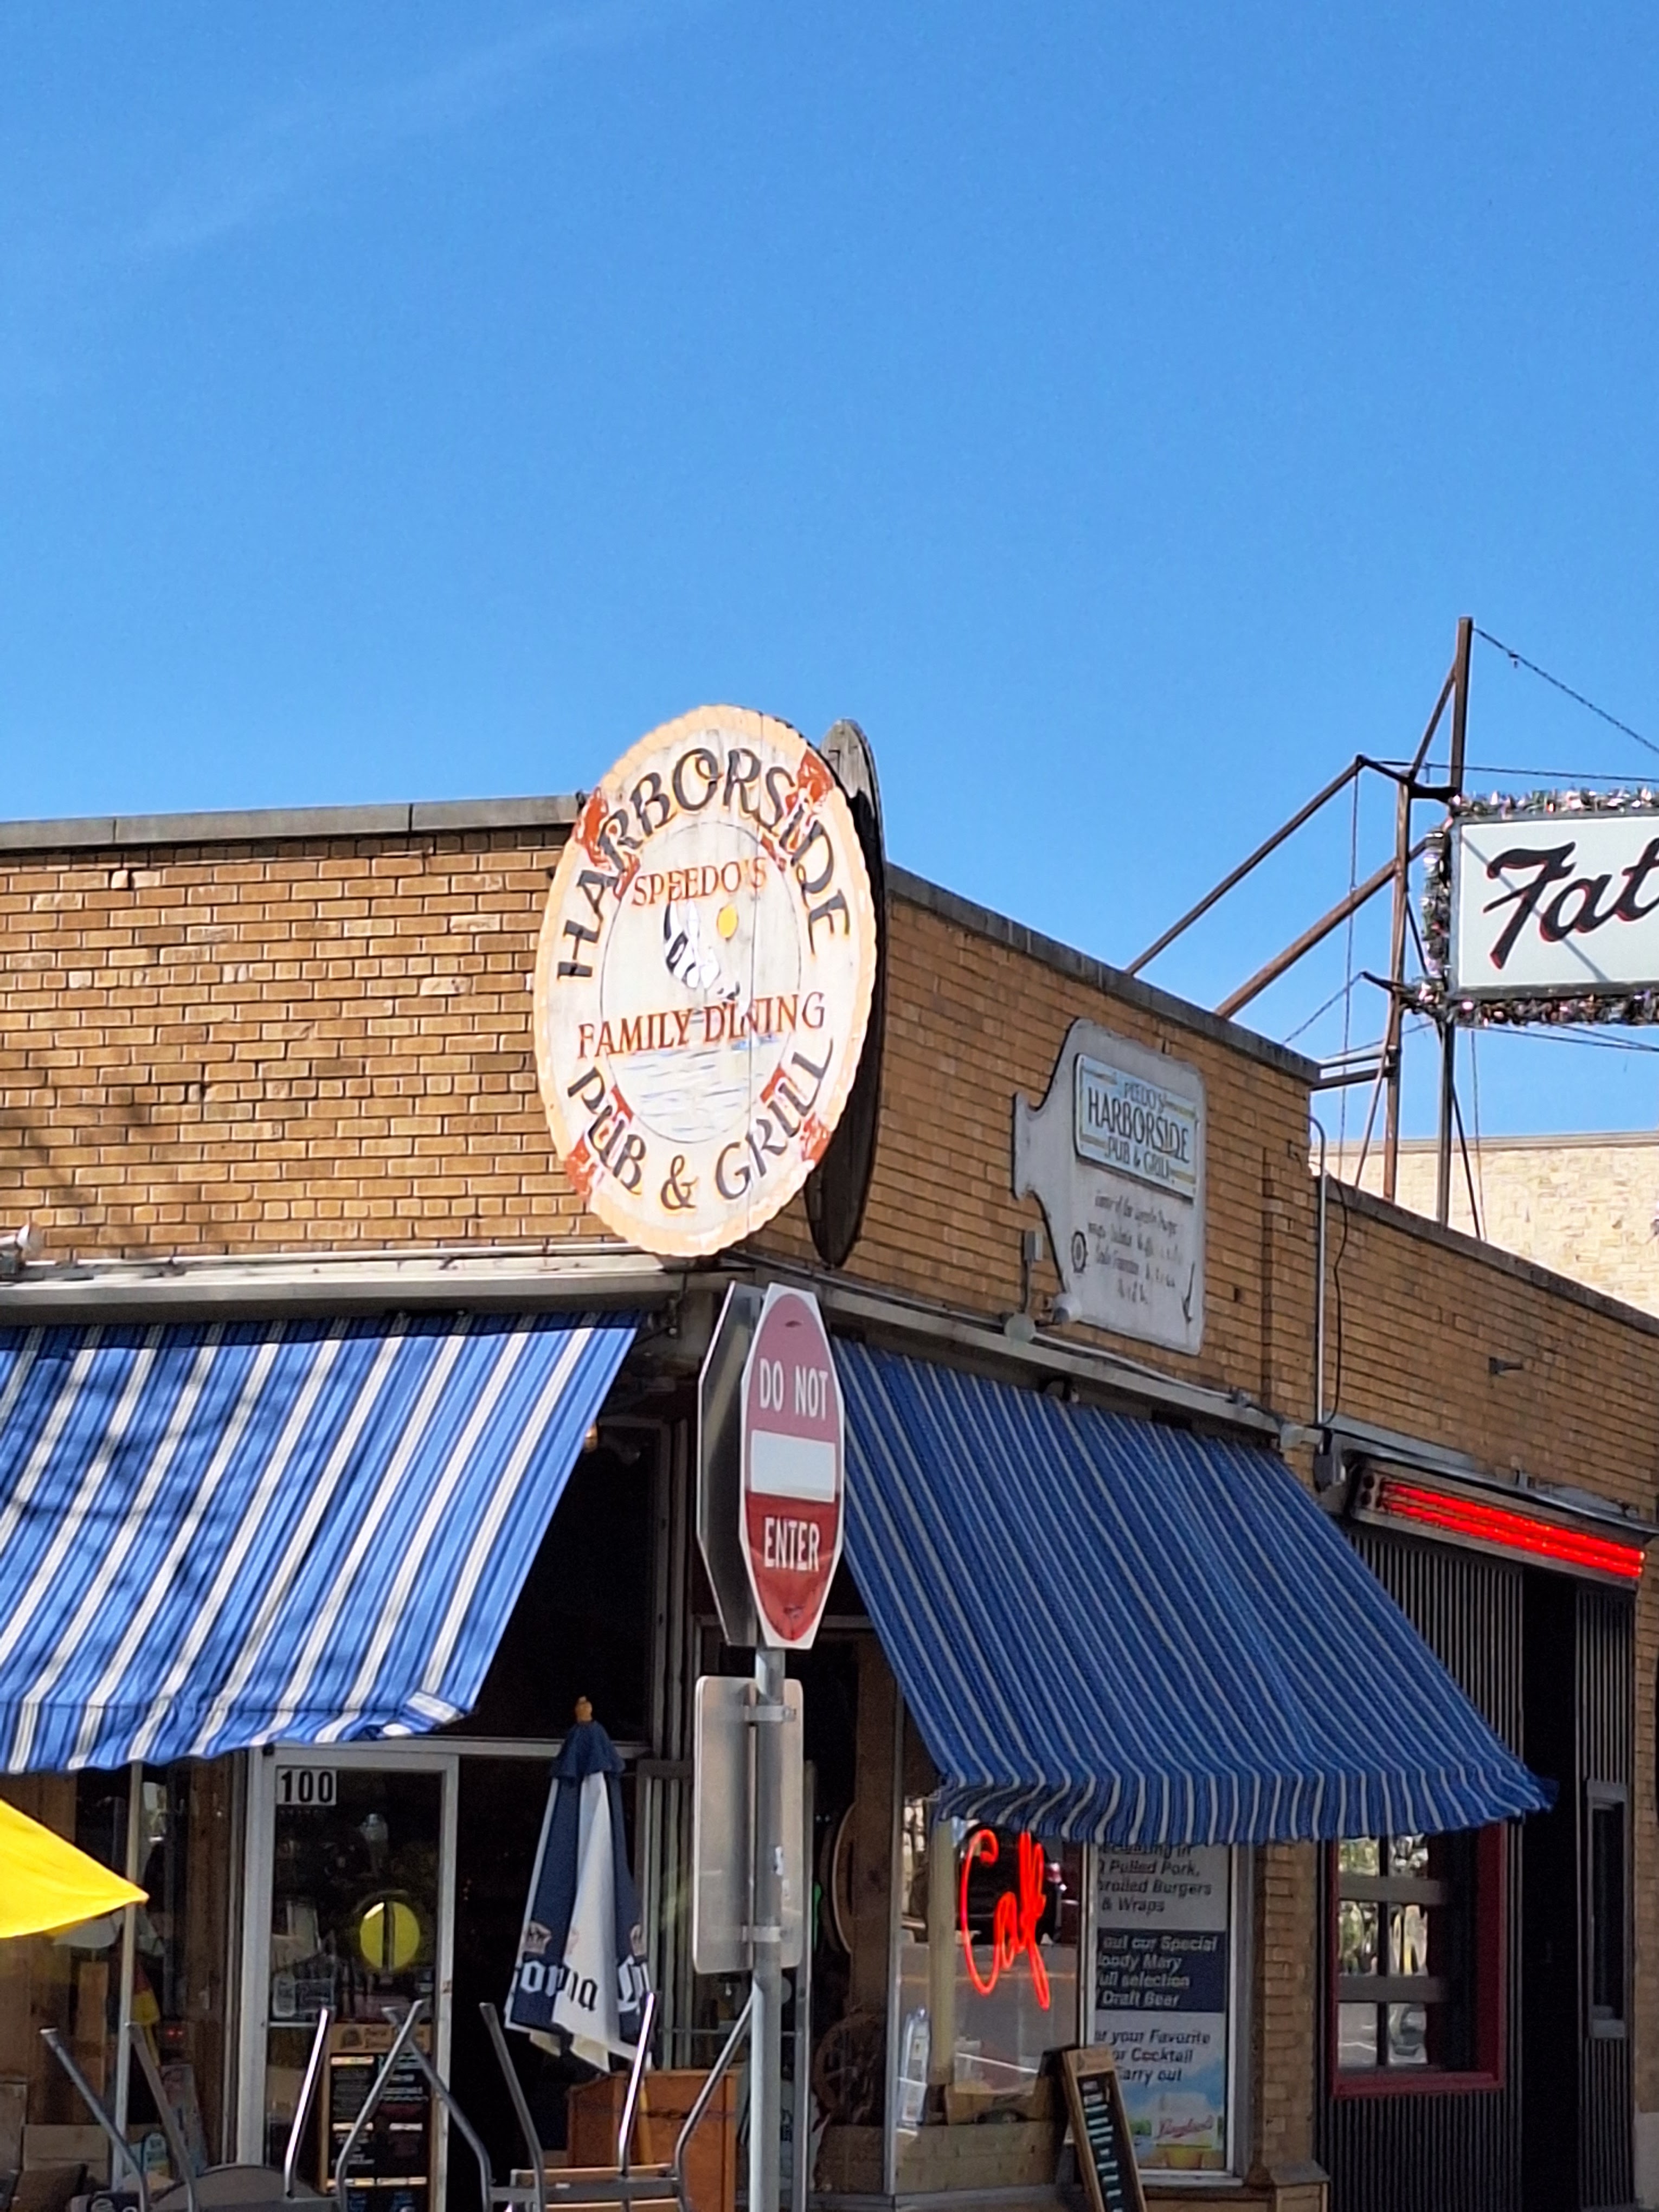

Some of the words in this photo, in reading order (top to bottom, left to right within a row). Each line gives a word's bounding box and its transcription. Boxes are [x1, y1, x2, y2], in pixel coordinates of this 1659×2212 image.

[558, 747, 850, 979] HARBORSIDE
[578, 1007, 692, 1059] FAMILY
[703, 991, 825, 1043] DINING
[568, 1066, 646, 1195] PUB
[661, 1155, 699, 1211] &
[715, 1036, 833, 1200] GRILL
[1088, 1086, 1190, 1164] HARBORSIDE
[1105, 1136, 1130, 1165] PUB
[760, 1358, 785, 1411] DO
[795, 1365, 829, 1420] NOT
[764, 1516, 819, 1572] ENTER
[281, 1770, 333, 1803] 100
[1152, 1879, 1212, 1898] Burgers
[1118, 1896, 1165, 1917] Wraps
[1143, 1953, 1182, 1976] Mary
[1109, 2031, 1144, 2047] your
[1149, 2028, 1211, 2044] Favorite
[1131, 2047, 1193, 2064] Cocktail
